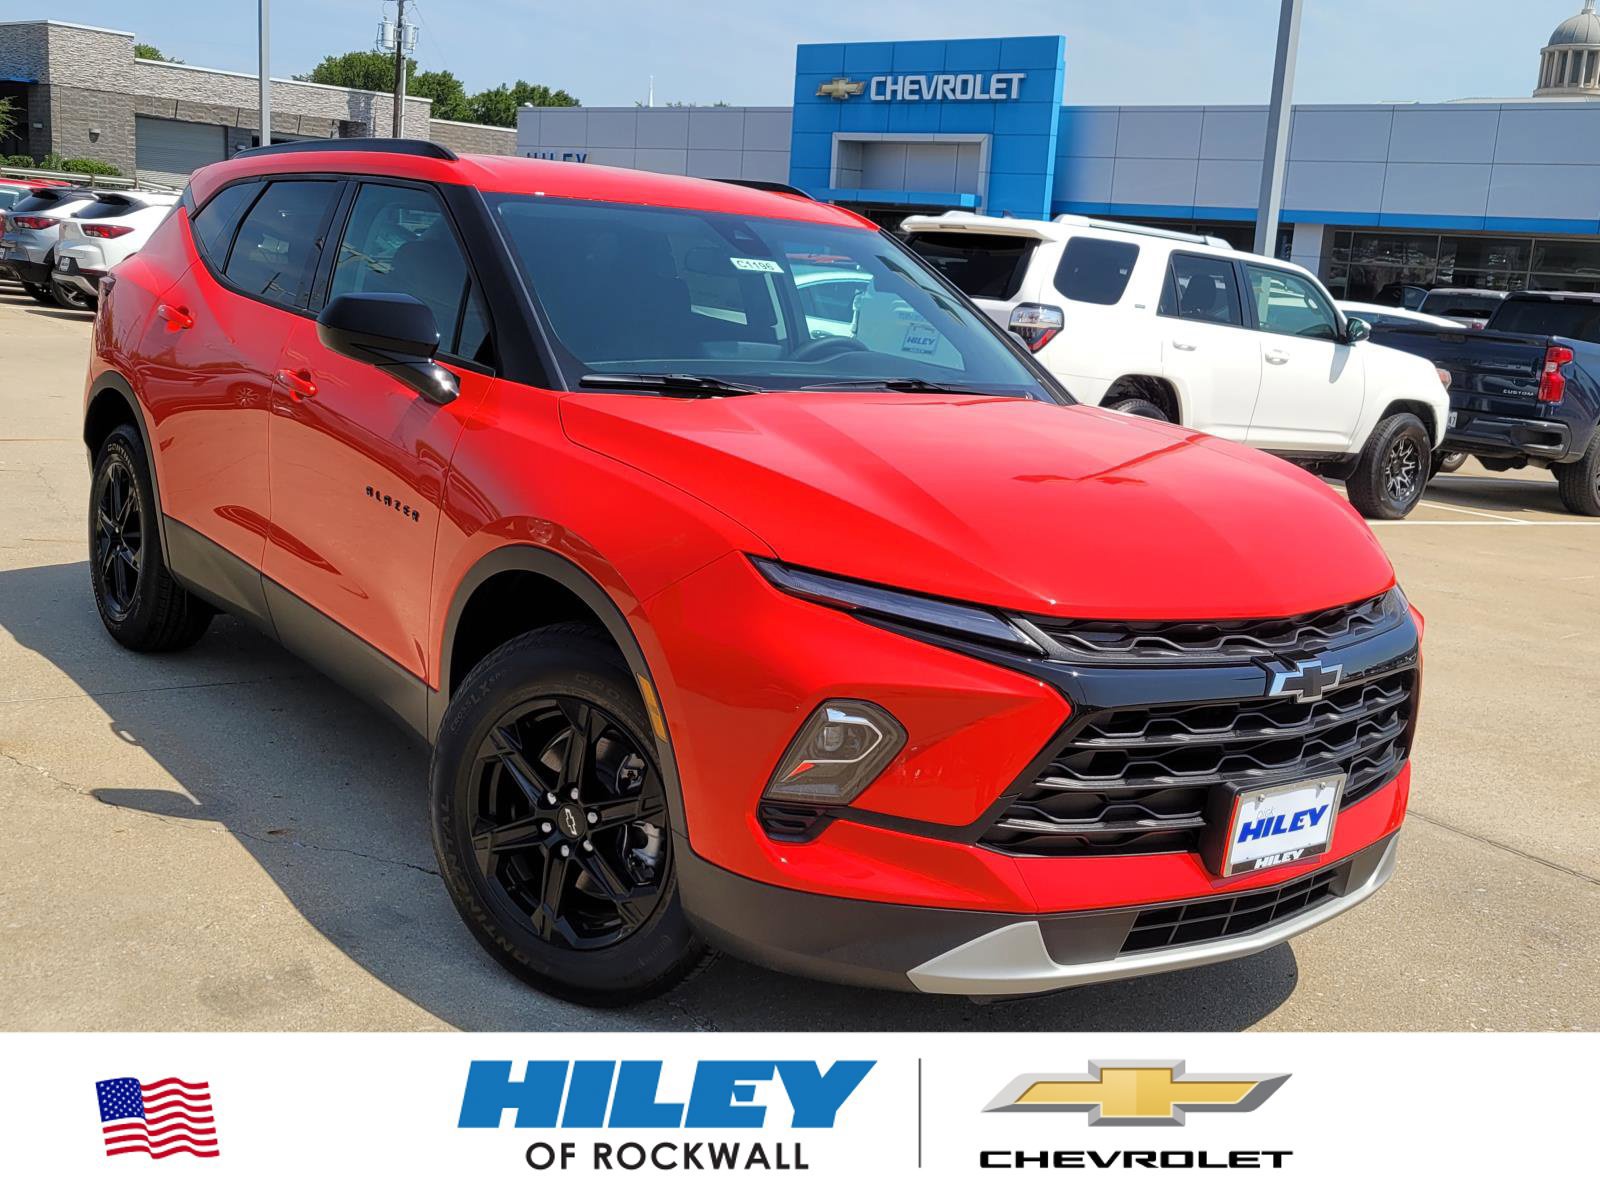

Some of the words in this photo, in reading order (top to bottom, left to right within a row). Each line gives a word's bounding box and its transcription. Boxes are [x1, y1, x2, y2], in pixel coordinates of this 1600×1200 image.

[870, 73, 1027, 100] CHEVROLET
[906, 336, 936, 345] HILEY
[365, 486, 419, 523] BLAZER
[1237, 804, 1329, 844] HILEY
[1254, 849, 1305, 870] HILEY
